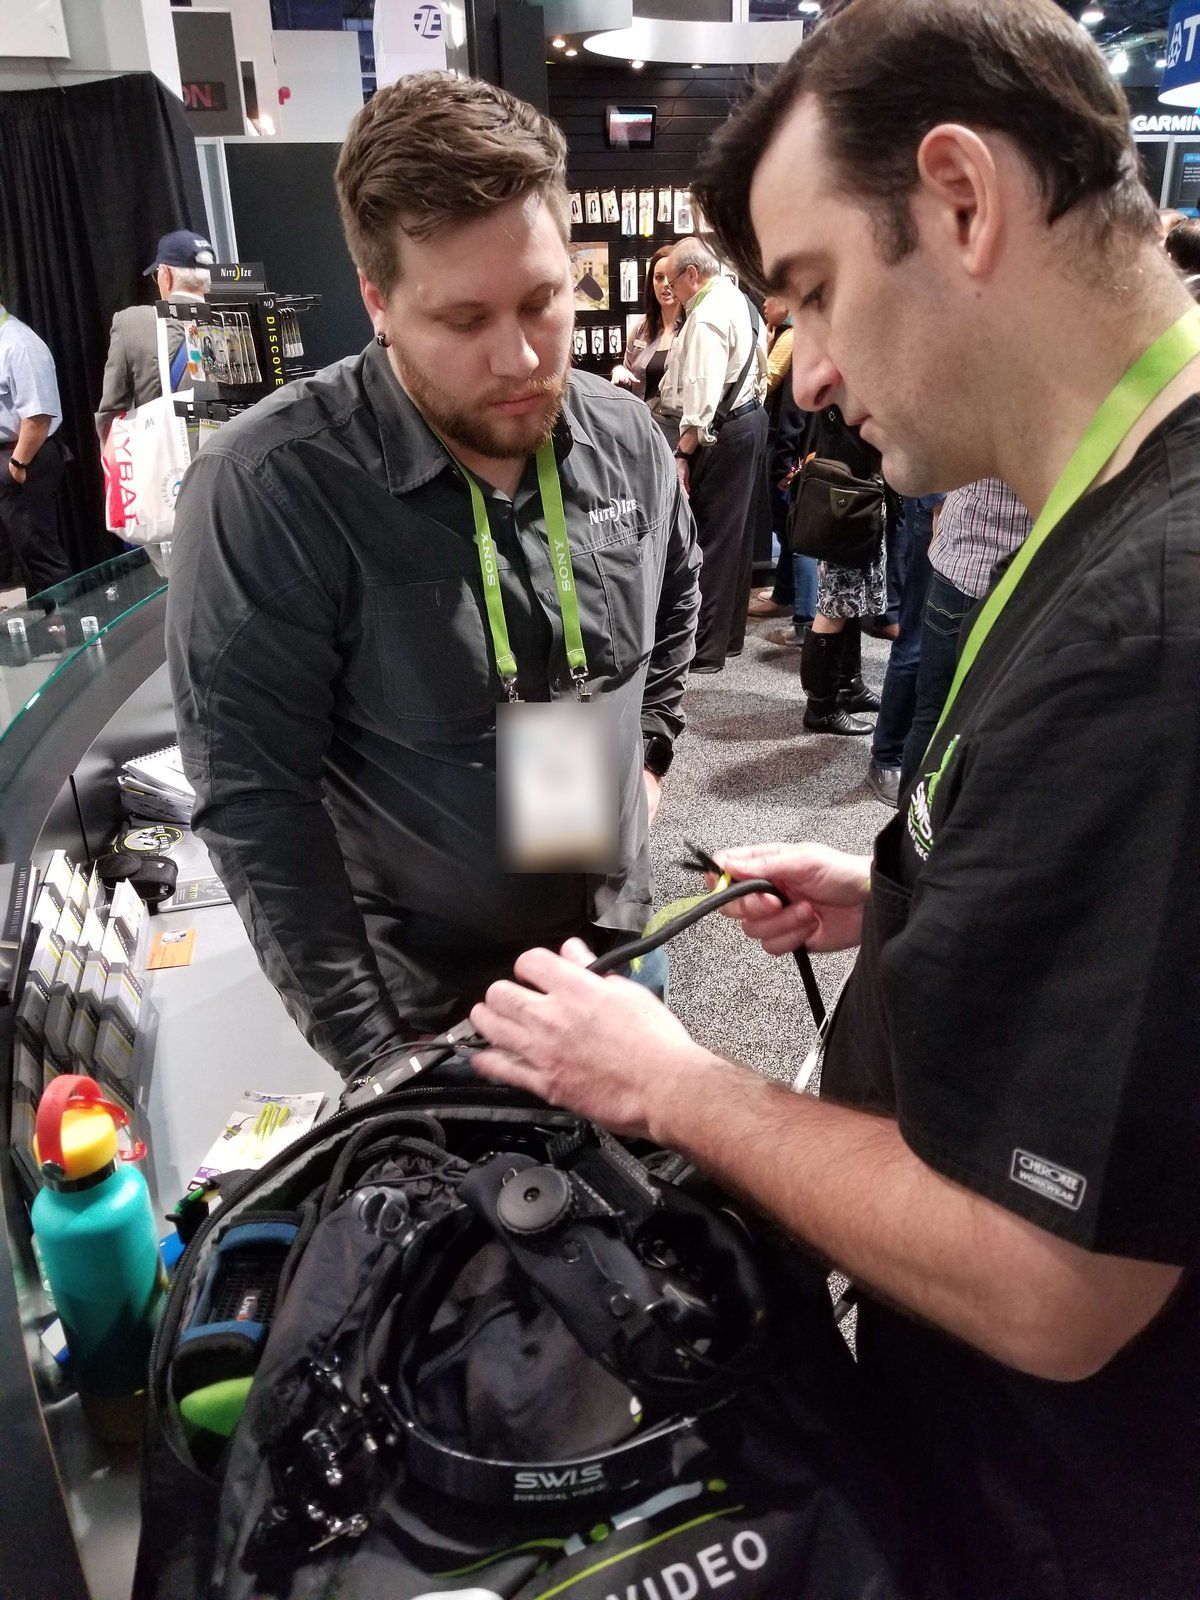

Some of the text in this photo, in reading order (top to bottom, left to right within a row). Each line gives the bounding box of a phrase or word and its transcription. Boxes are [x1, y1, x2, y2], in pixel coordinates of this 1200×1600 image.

[588, 499, 638, 526] NITE IZE
[480, 532, 496, 586] SONY
[554, 539, 571, 592] SONY
